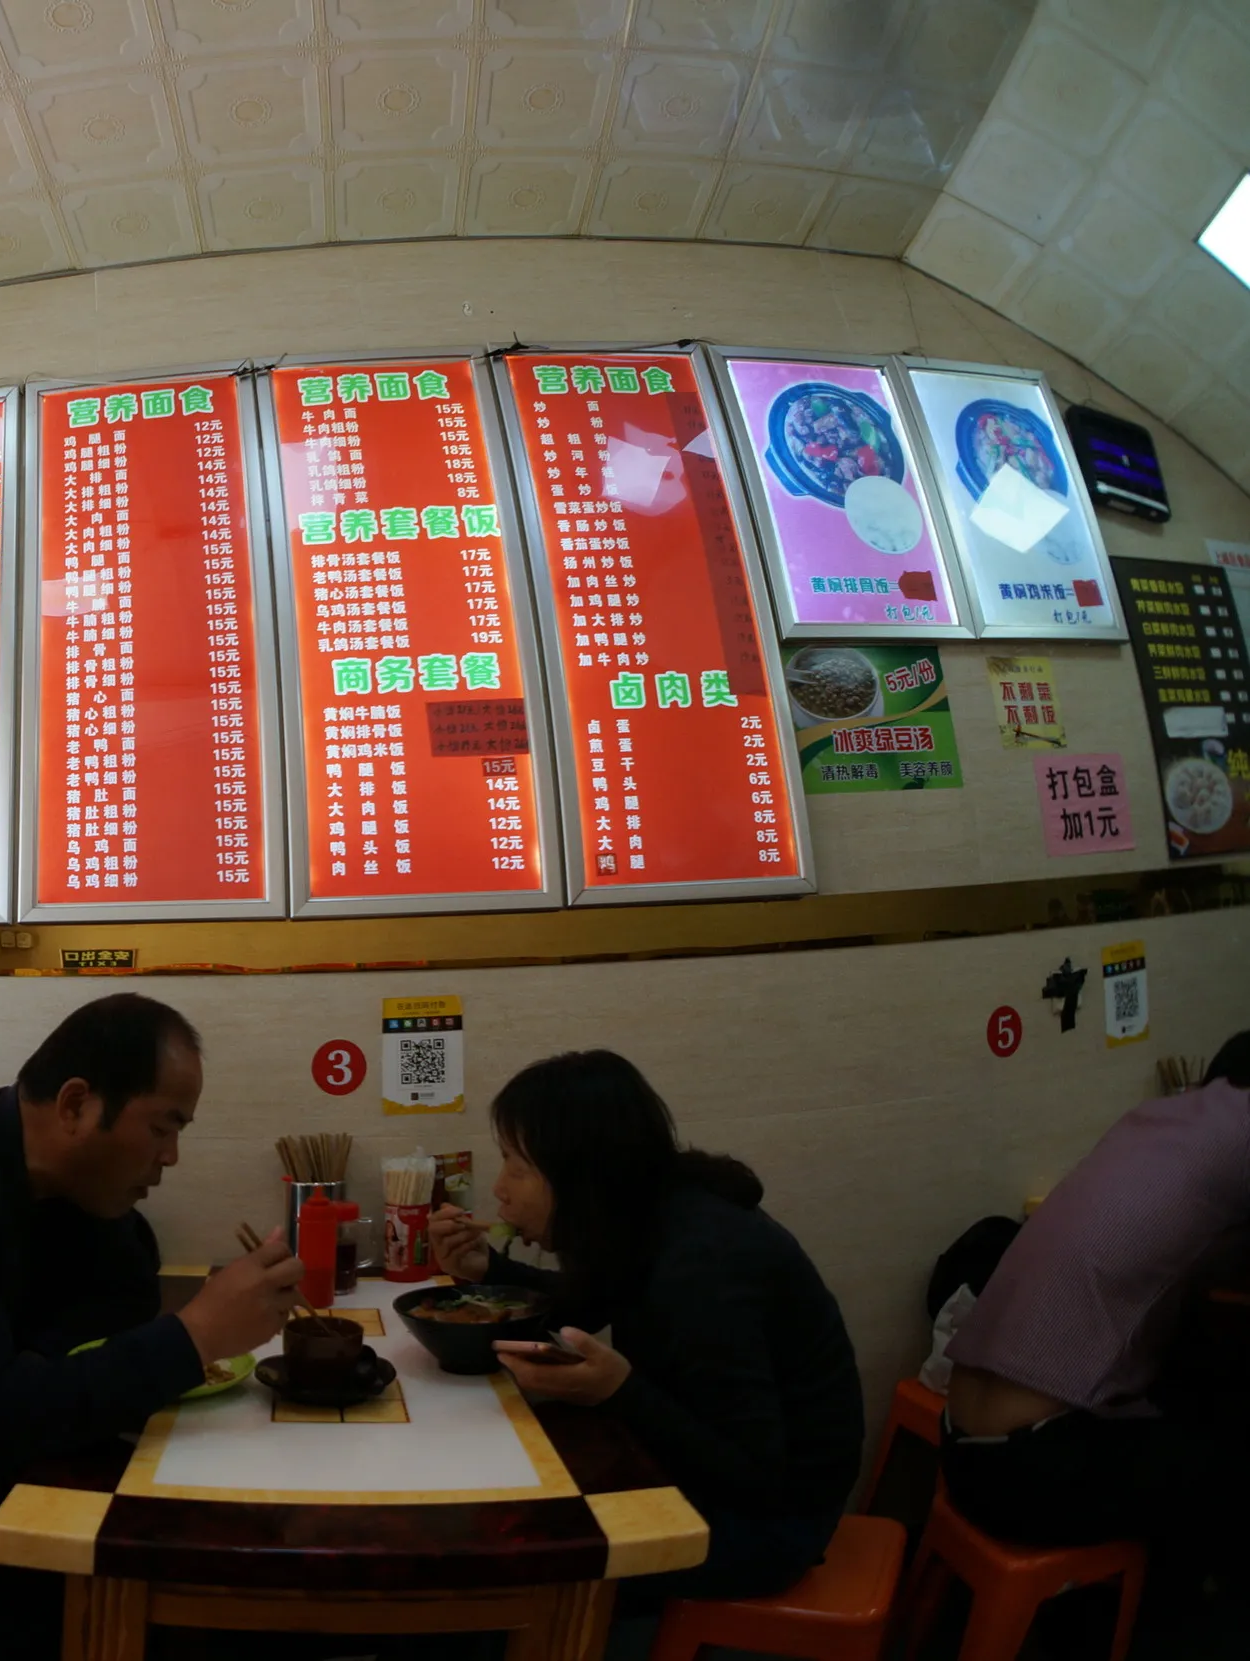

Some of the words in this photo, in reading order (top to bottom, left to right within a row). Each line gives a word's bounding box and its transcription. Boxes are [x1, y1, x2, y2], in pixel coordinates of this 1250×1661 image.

[297, 370, 450, 406] 营养面食
[532, 364, 675, 395] 营养面食
[67, 385, 213, 428] 营养面食
[438, 416, 466, 427] 15元
[195, 432, 223, 444] 12元
[198, 472, 227, 483] 14元
[201, 513, 230, 525] 14元
[298, 503, 501, 545] 营养套餐饭
[311, 551, 400, 567] 排骨汤套餐饭
[460, 548, 490, 560] 17元
[312, 567, 402, 583] 老鸭汤套餐饭
[462, 564, 493, 576] 17元
[314, 584, 404, 600] 猪心汤套餐饭
[464, 580, 495, 592] 17元
[316, 600, 406, 617] 乌鸡汤套餐饭
[467, 597, 498, 609] 17元
[317, 618, 407, 634] 牛肉汤套餐饭
[469, 613, 500, 626] 17元
[318, 635, 409, 652] 乳鸽汤套餐饭
[471, 630, 502, 643] 19元
[208, 648, 240, 661] 15元
[331, 652, 501, 696] 商务套餐
[884, 658, 936, 692] 5元/份
[609, 669, 738, 710] 卤肉类
[999, 681, 1053, 701] 不剩菜
[211, 697, 242, 710] 15元
[323, 704, 400, 721] 黄焖牛腩饭
[740, 716, 761, 728] 2元
[1004, 705, 1058, 724] 不剩饭
[324, 723, 402, 739] 黄焖排骨饭
[832, 726, 934, 754] 冰爽绿豆汤
[743, 734, 764, 747] 2元
[213, 747, 244, 760] 15元
[326, 742, 404, 758] 黄焖鸡米饭
[483, 759, 515, 774] 15元
[746, 753, 767, 766] 2元
[749, 771, 770, 784] 6元
[821, 763, 879, 781] 清热解毒
[1045, 764, 1119, 800] 打包盒
[214, 798, 247, 811] 15元
[1060, 806, 1120, 841] 加1元
[490, 835, 523, 849] 12元
[216, 851, 248, 864] 15元
[492, 855, 524, 869] 12元
[216, 868, 249, 882] 15元
[997, 1014, 1015, 1050] 5
[326, 1049, 353, 1086] 3
